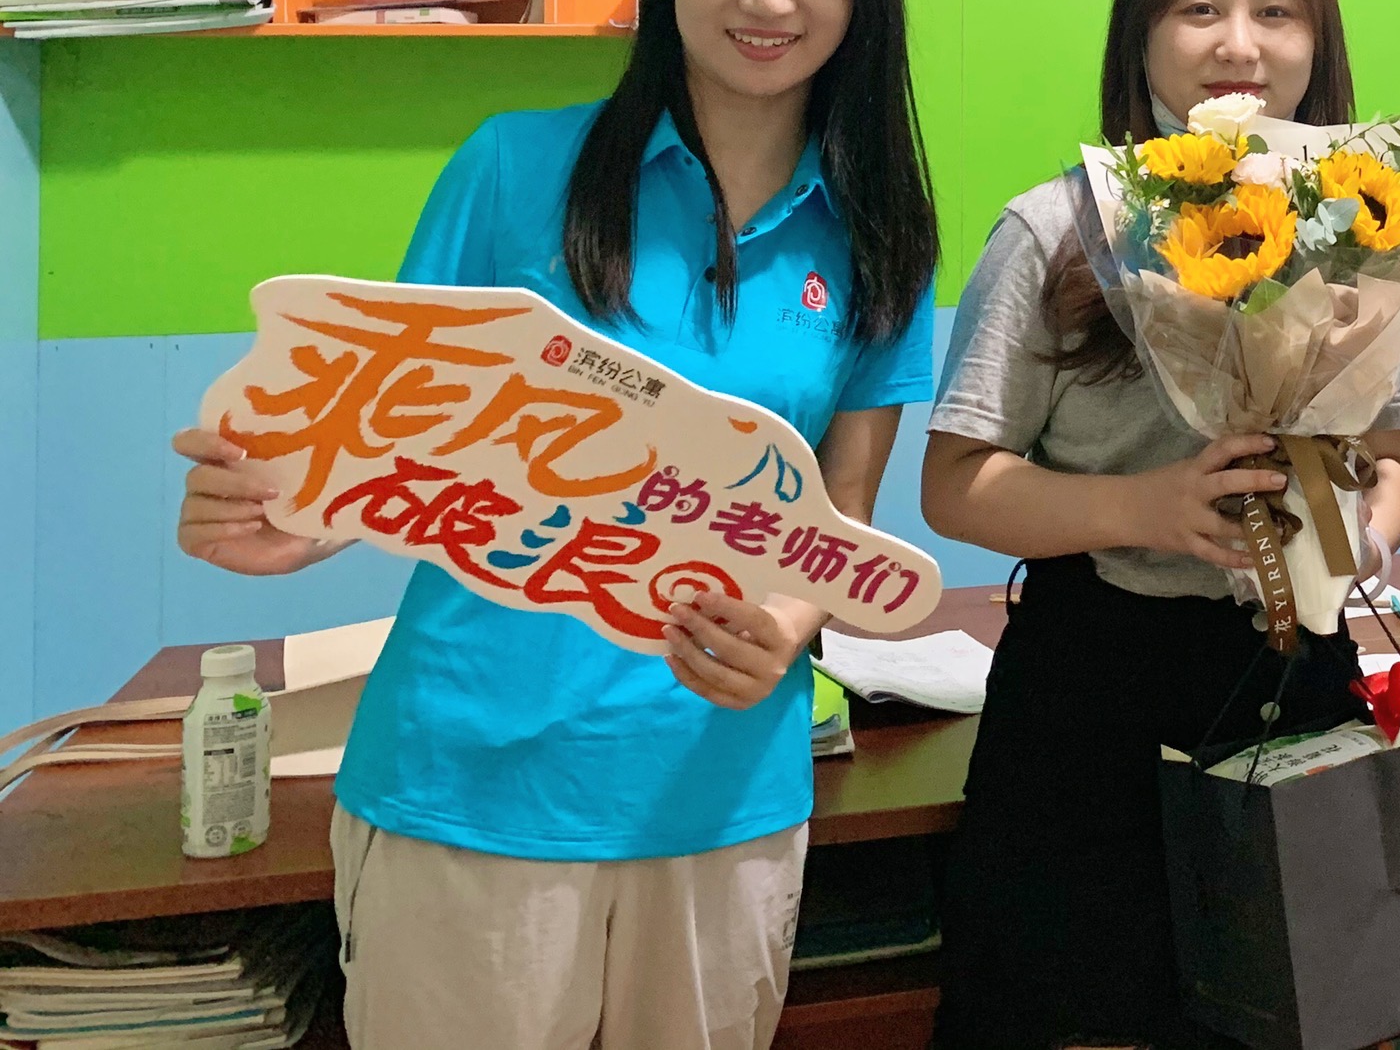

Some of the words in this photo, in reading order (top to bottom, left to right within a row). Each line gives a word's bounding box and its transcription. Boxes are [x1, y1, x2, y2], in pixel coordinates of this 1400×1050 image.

[573, 347, 666, 399] 滨纷公寓
[588, 373, 607, 386] FEN
[218, 292, 658, 513] 乘风
[638, 466, 920, 615] 的老师们
[1273, 614, 1293, 651] 一花
